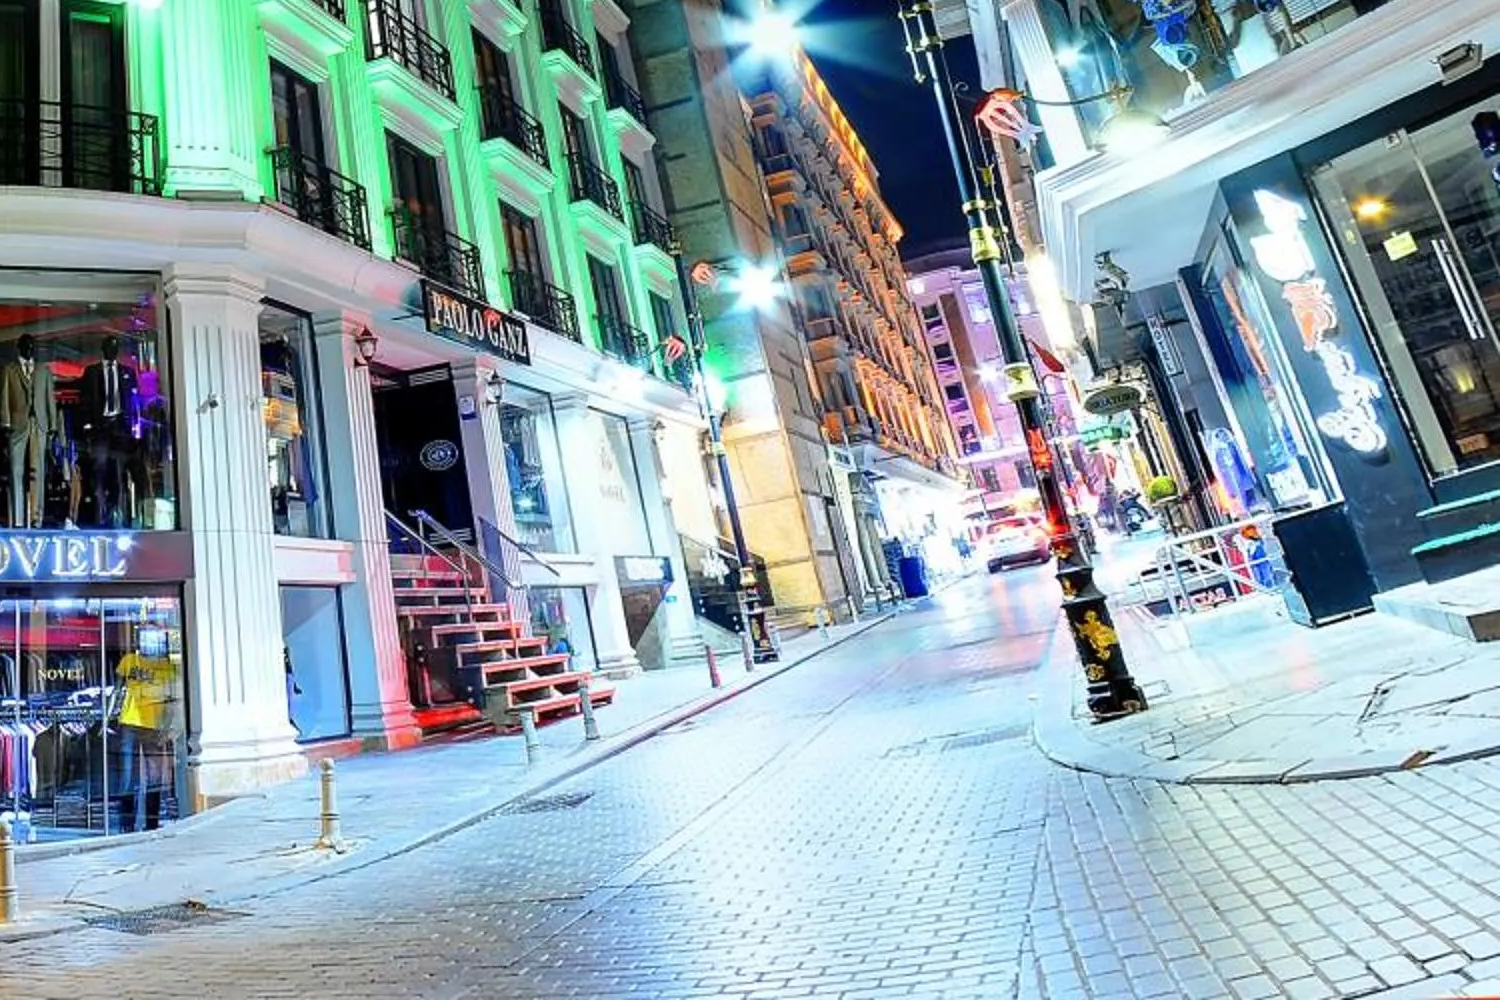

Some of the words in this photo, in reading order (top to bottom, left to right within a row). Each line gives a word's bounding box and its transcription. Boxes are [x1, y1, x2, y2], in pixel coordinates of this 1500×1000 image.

[431, 291, 485, 341] PAOLO
[487, 315, 527, 357] GANZ
[37, 668, 85, 681] NOVEL
